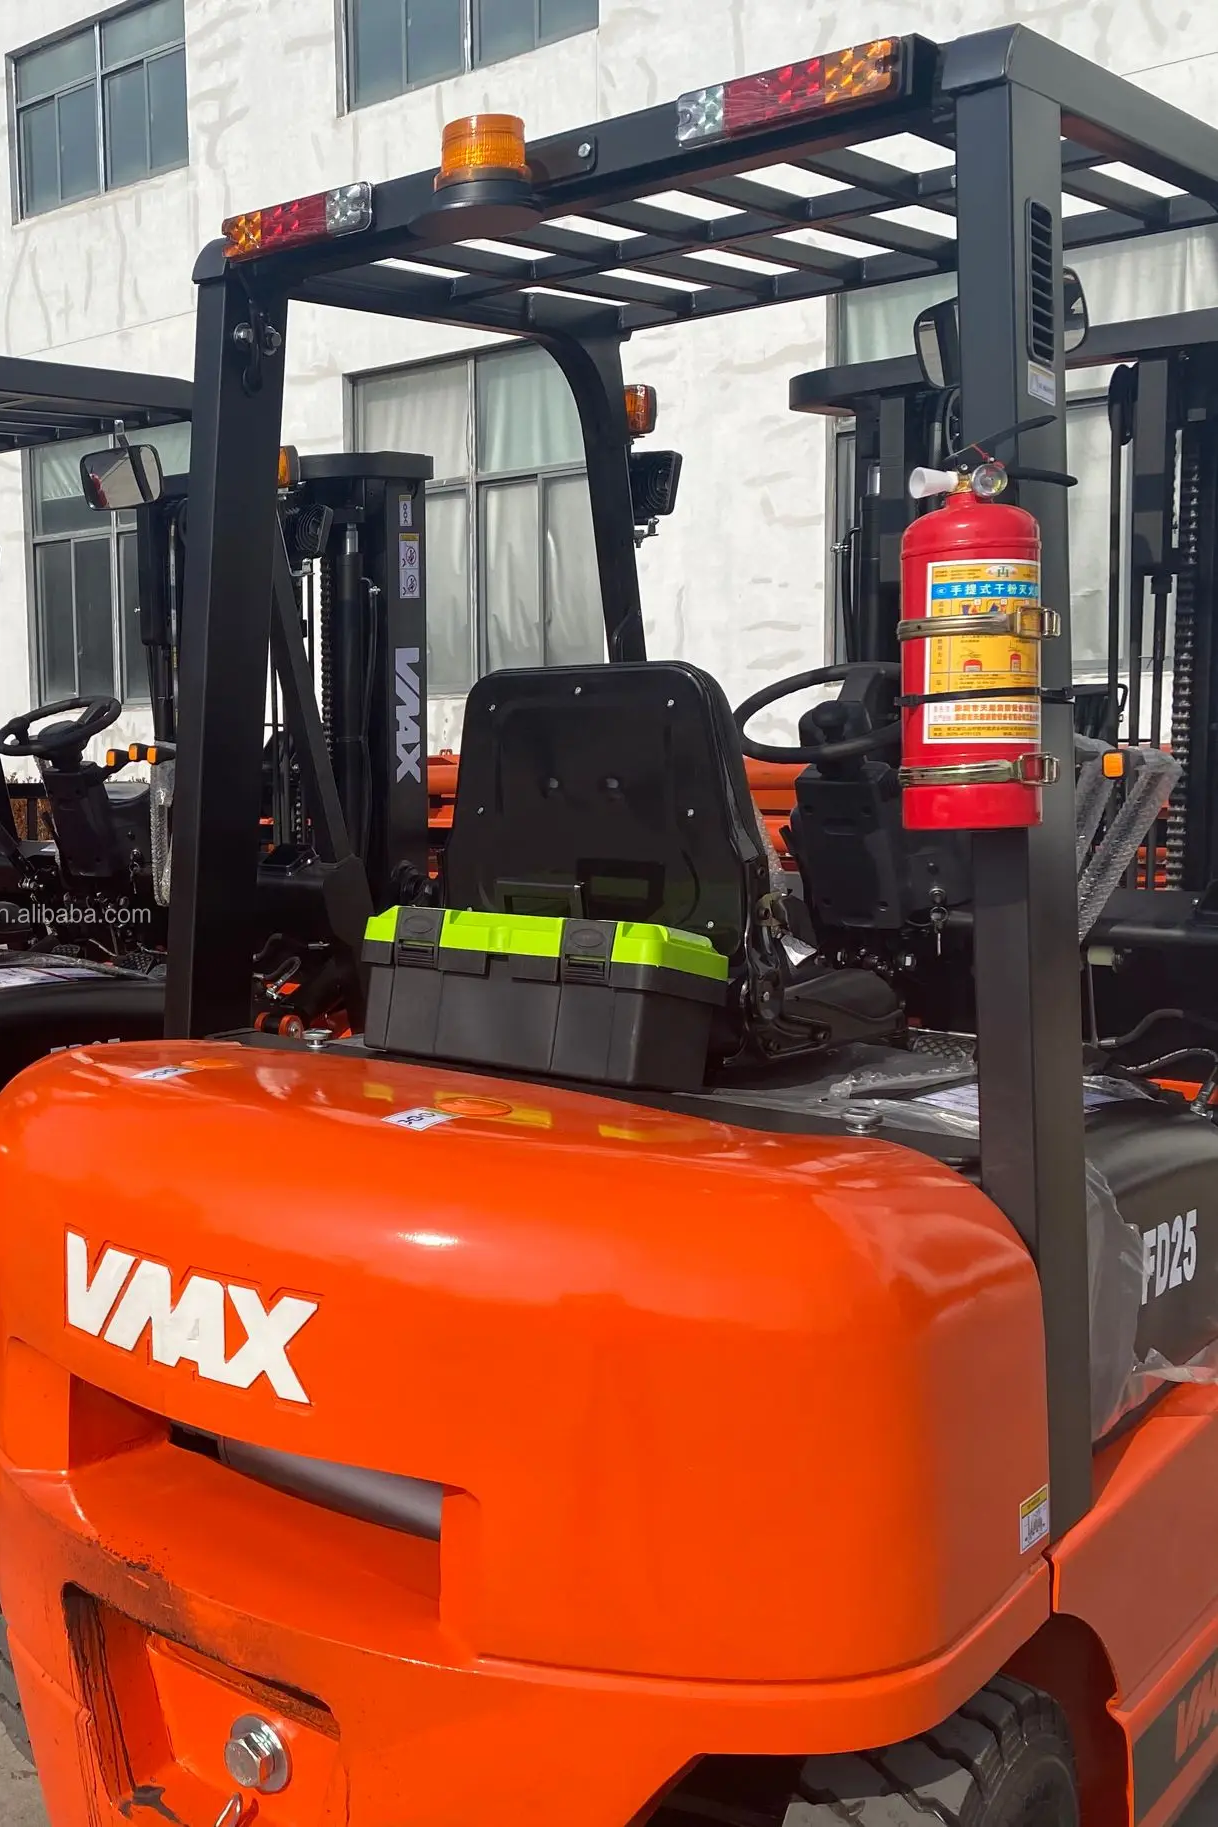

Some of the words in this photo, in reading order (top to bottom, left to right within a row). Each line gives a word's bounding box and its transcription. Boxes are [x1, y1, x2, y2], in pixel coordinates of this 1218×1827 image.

[950, 583, 1038, 596] 手提式干粉灭火
[395, 647, 421, 784] VMAX
[1141, 1209, 1198, 1306] FD25
[67, 1231, 319, 1405] VMAX
